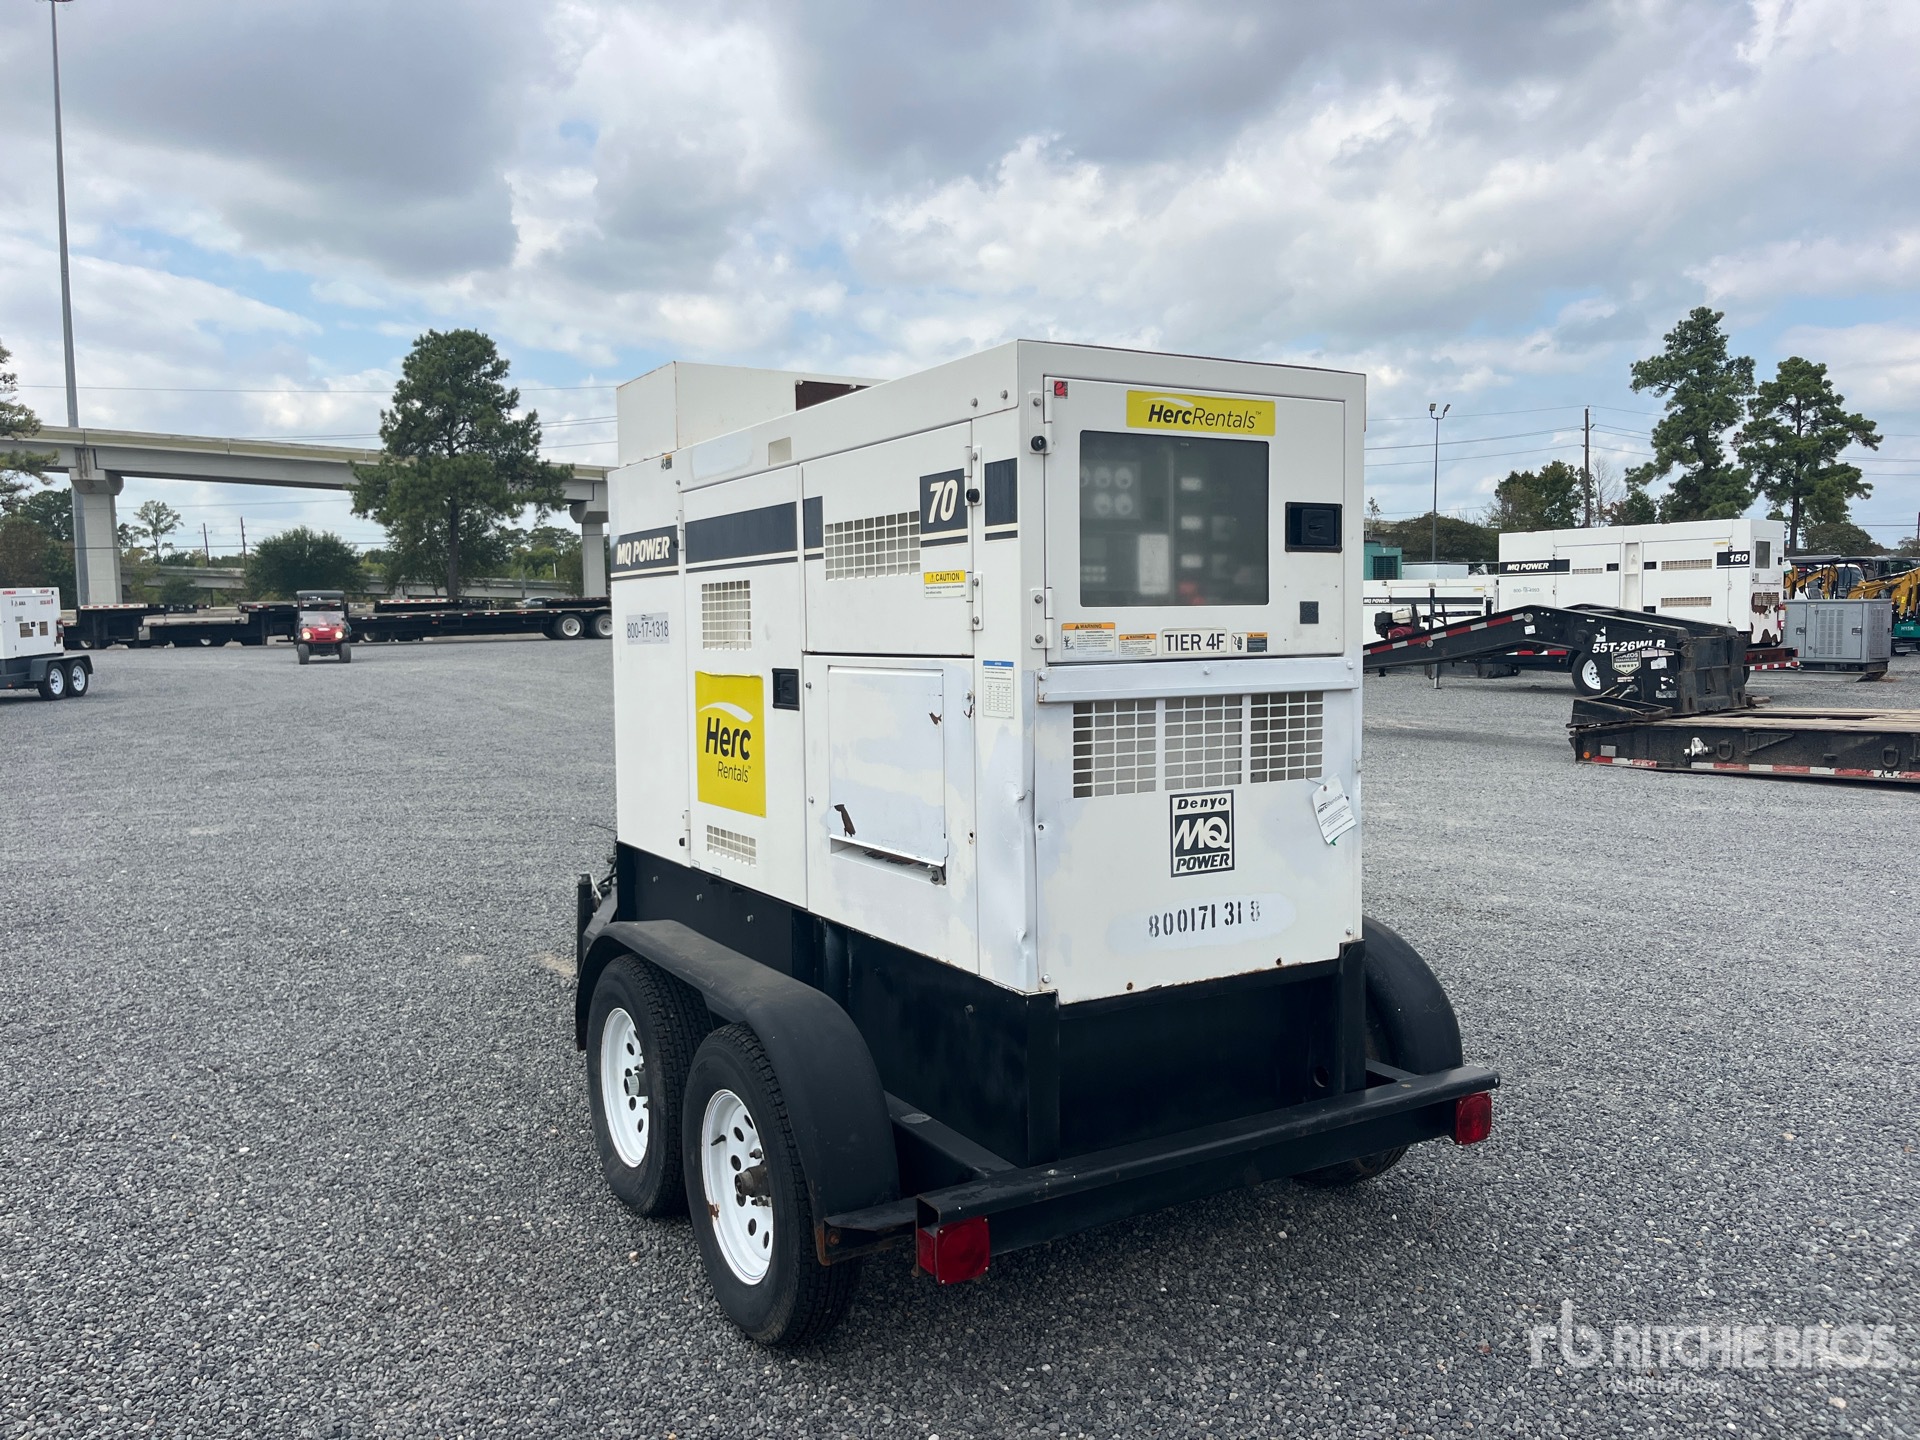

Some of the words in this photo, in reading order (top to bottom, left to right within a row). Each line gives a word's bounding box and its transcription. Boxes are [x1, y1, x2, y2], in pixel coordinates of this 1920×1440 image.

[928, 479, 958, 524] 70
[616, 541, 632, 567] MQ
[632, 536, 670, 563] POWER
[1730, 554, 1748, 562] 150
[1507, 563, 1519, 571] MQ
[1520, 562, 1549, 570] POWER
[935, 572, 960, 582] CAUTION
[627, 620, 669, 639] 800-17-1318
[1164, 634, 1202, 651] TIER
[1206, 633, 1225, 650] 4F
[705, 717, 752, 760] Herc
[717, 760, 750, 783] Rentals
[1177, 797, 1228, 810] Denyo
[1174, 816, 1231, 850] MQ
[1175, 853, 1230, 872] POWER
